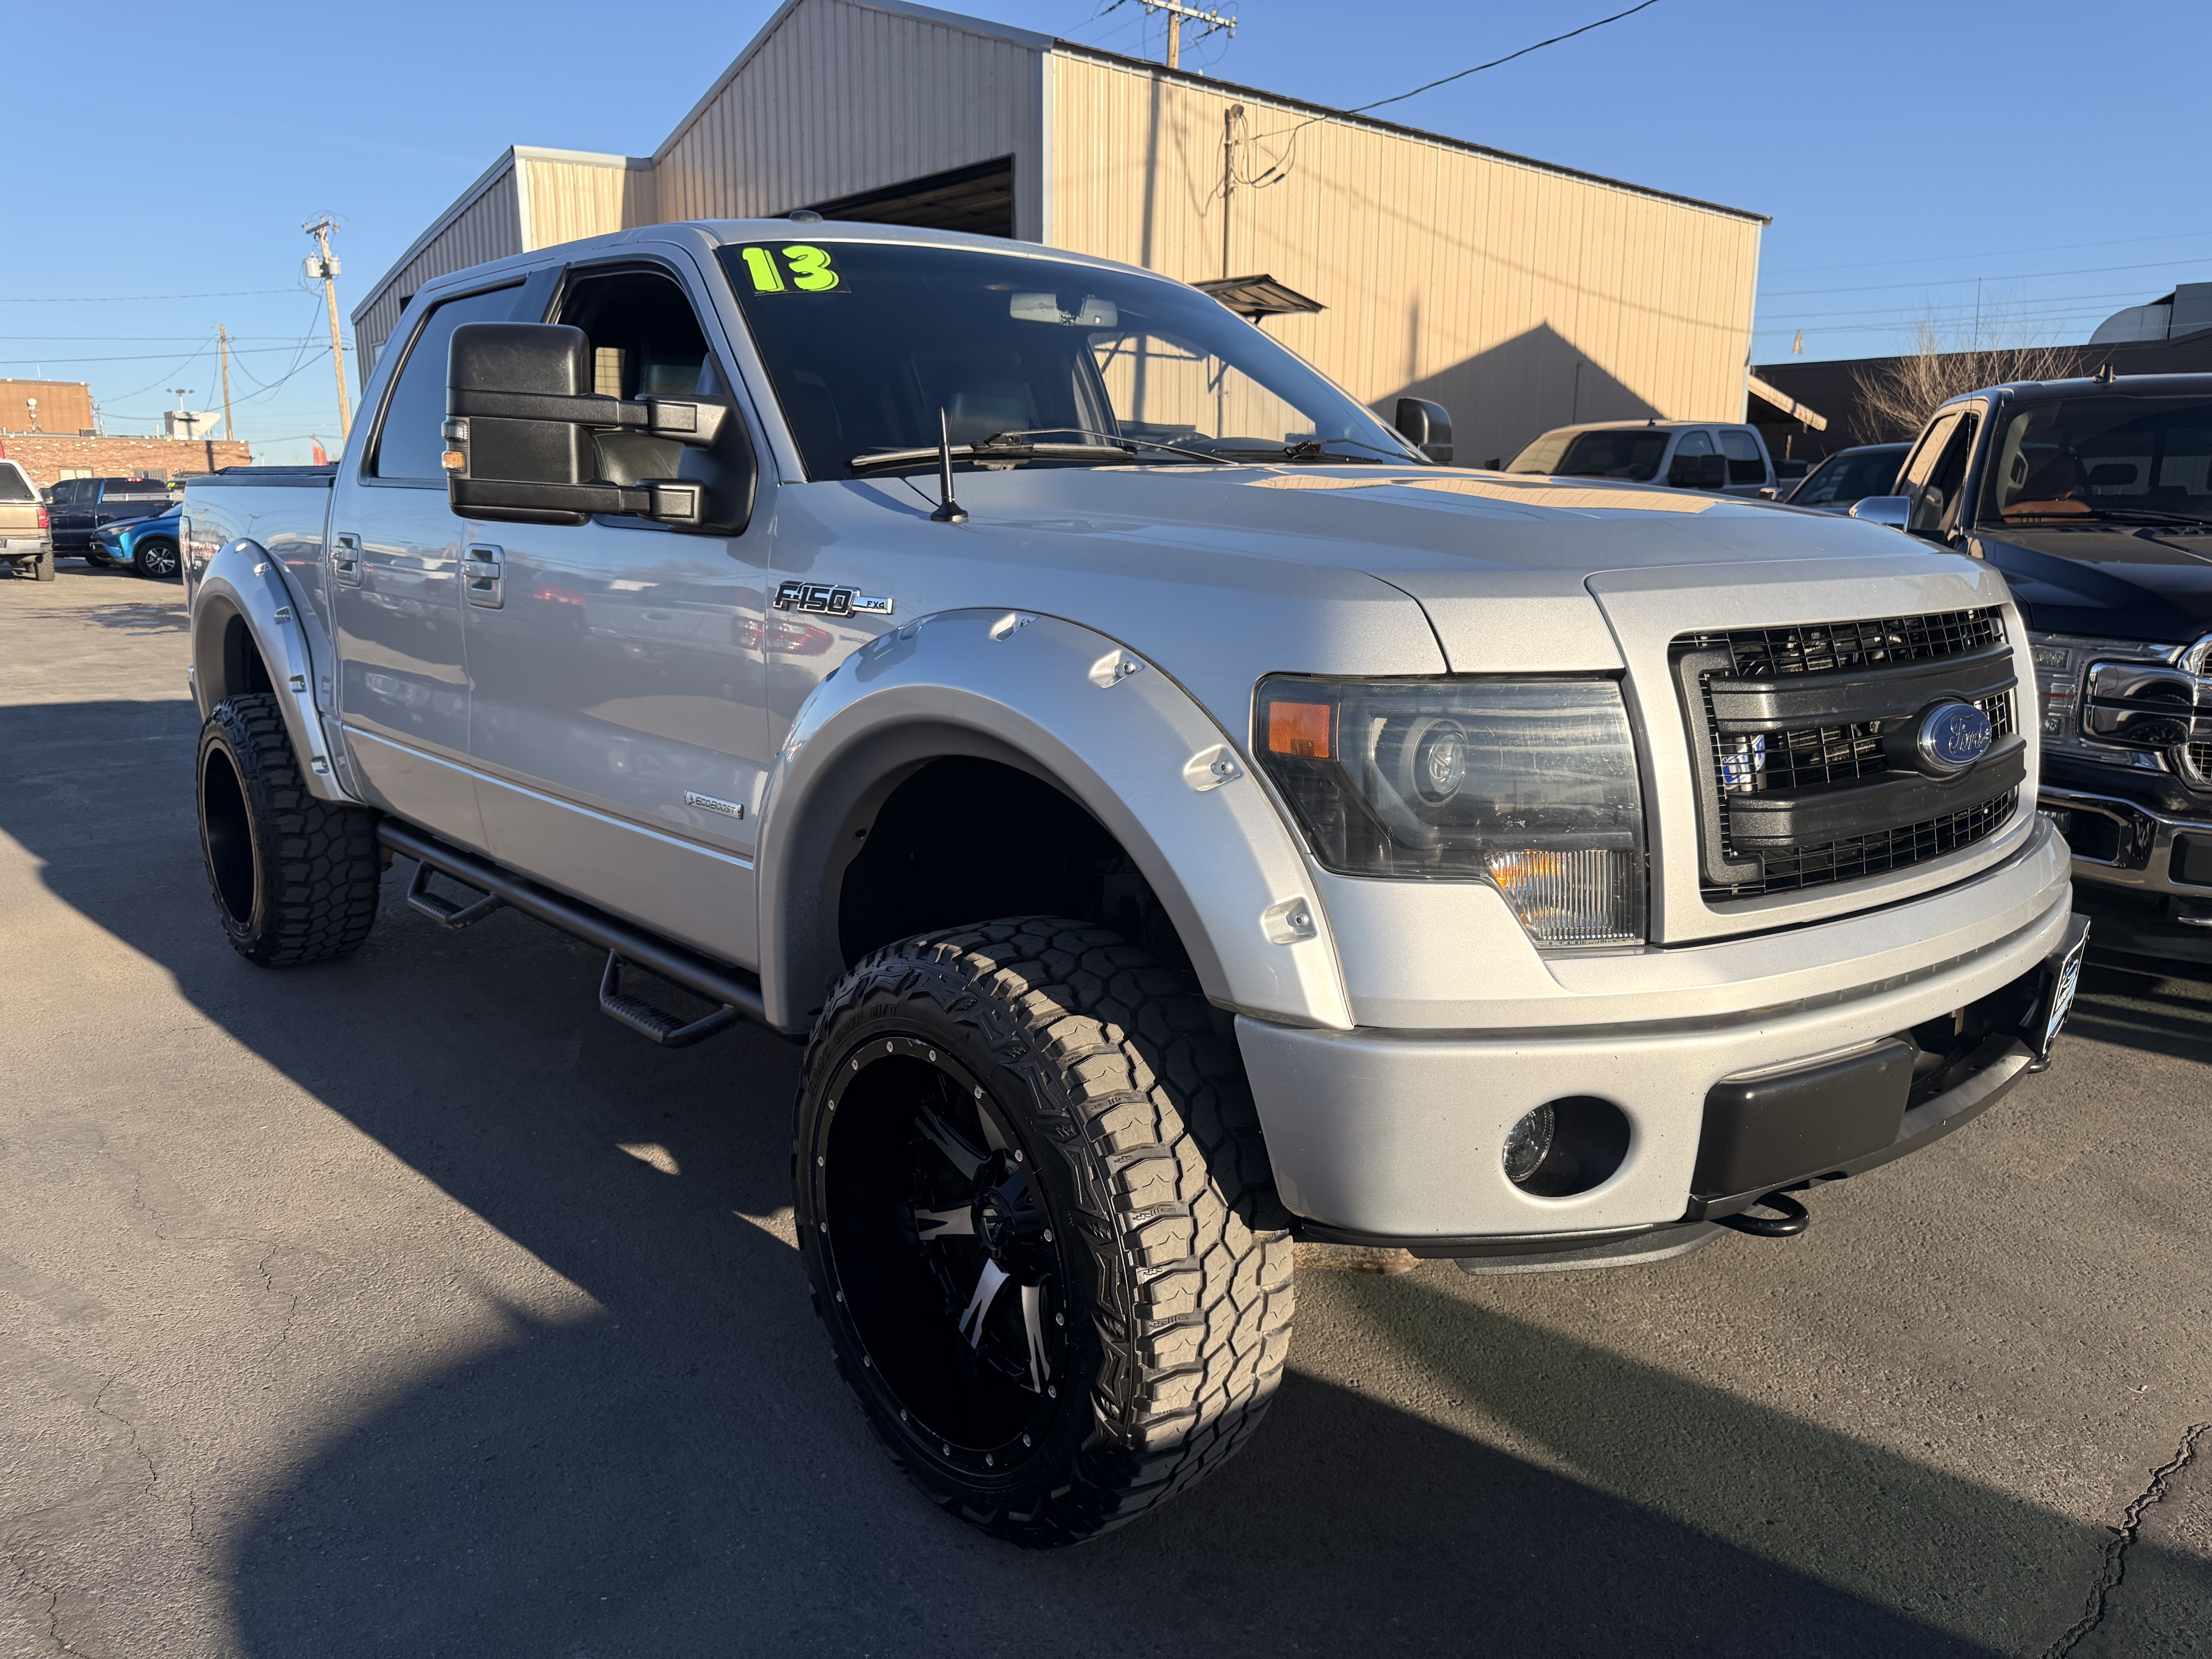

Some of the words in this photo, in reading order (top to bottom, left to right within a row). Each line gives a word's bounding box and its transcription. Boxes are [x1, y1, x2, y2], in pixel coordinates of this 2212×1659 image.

[743, 245, 839, 291] 13
[1949, 714, 1984, 754] Ford
[696, 797, 736, 814] ECOBOOST
[834, 1012, 863, 1043] GRIP
